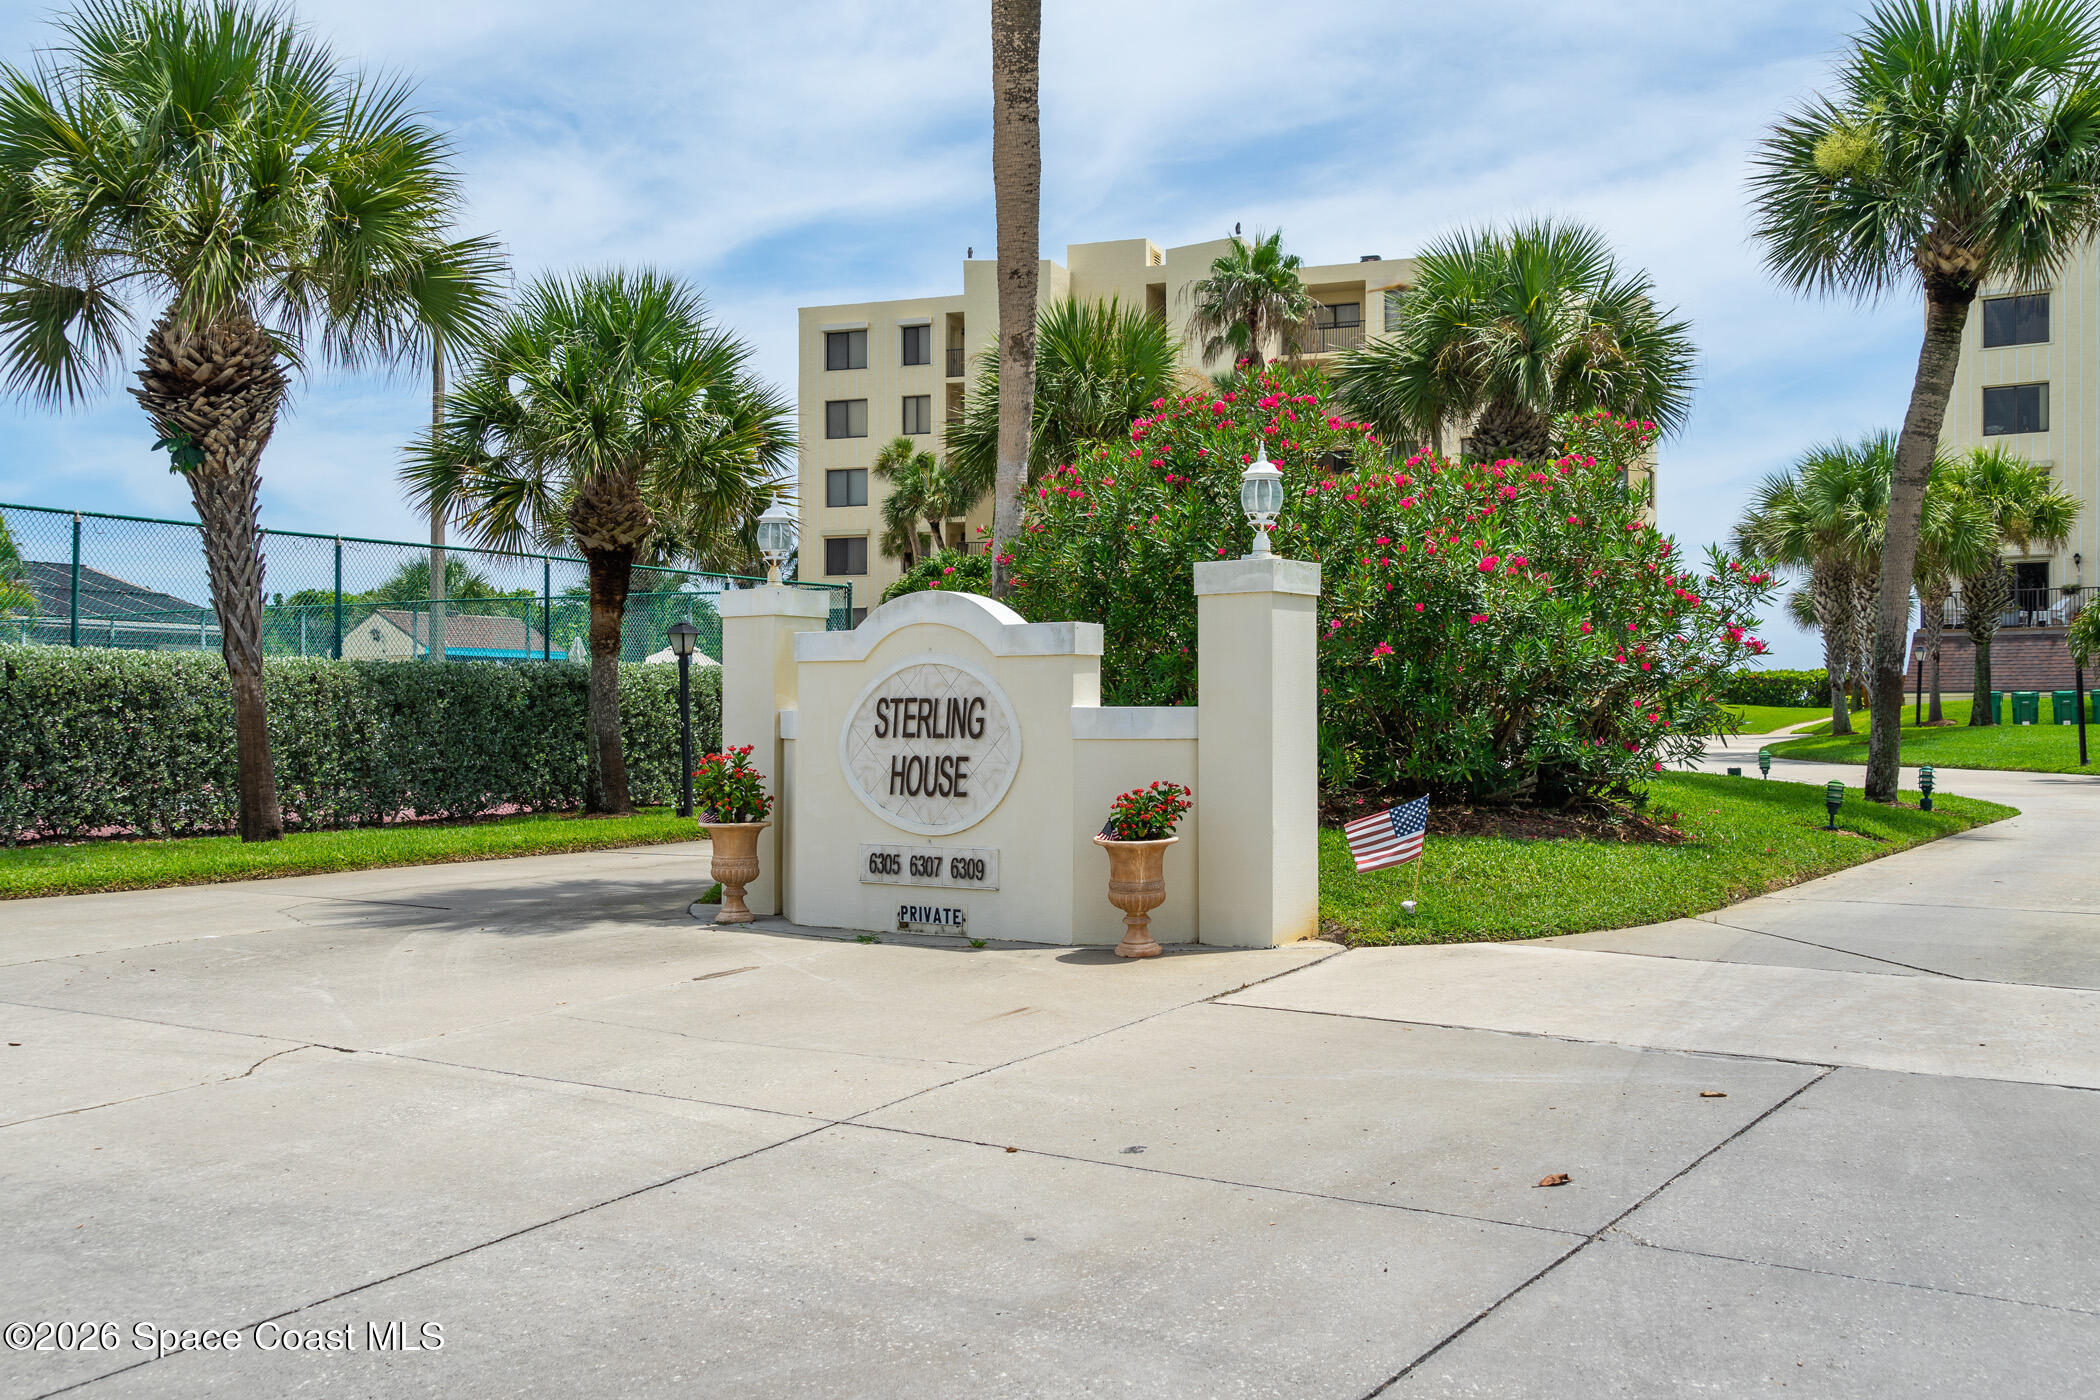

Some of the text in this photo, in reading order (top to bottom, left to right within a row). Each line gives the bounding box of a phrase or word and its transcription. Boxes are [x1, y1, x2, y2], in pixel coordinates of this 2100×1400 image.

[874, 697, 985, 739] STERLING
[889, 755, 970, 798] HOUSE
[869, 853, 984, 880] 6305 6307 6309
[900, 906, 962, 925] PRIVATE
